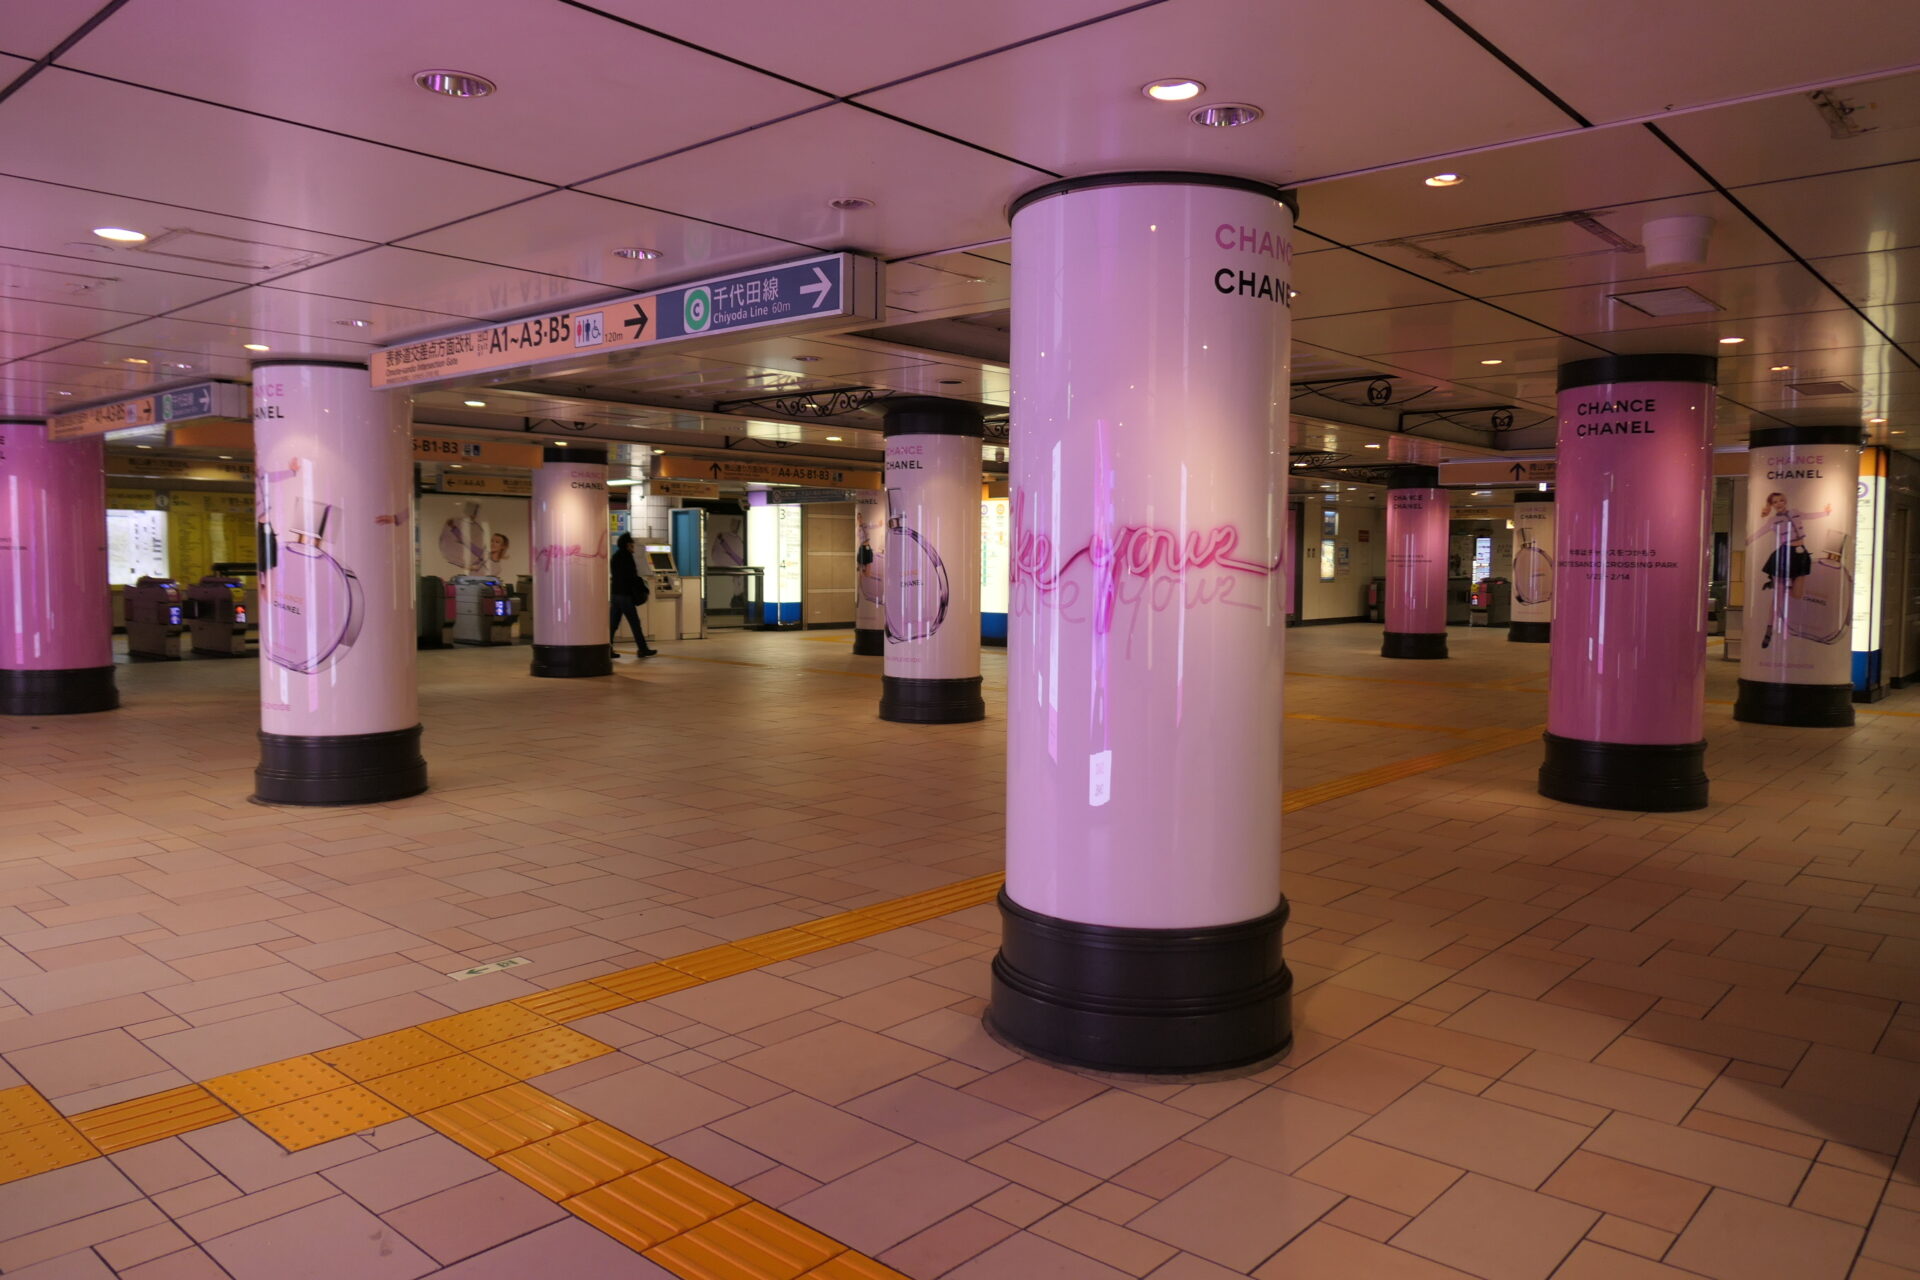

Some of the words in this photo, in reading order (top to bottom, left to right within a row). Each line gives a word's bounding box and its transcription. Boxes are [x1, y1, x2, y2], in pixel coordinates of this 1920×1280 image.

[713, 276, 779, 310] 千代田線
[713, 310, 748, 325] Chiyoda
[750, 306, 769, 318] Line
[772, 302, 791, 313] 60m
[604, 332, 623, 343] 120m
[1577, 399, 1656, 416] CHANCE
[1576, 421, 1655, 437] CHANEL
[1767, 455, 1824, 466] CHANCE
[1767, 469, 1823, 480] CHANEL
[1655, 560, 1679, 568] PARK
